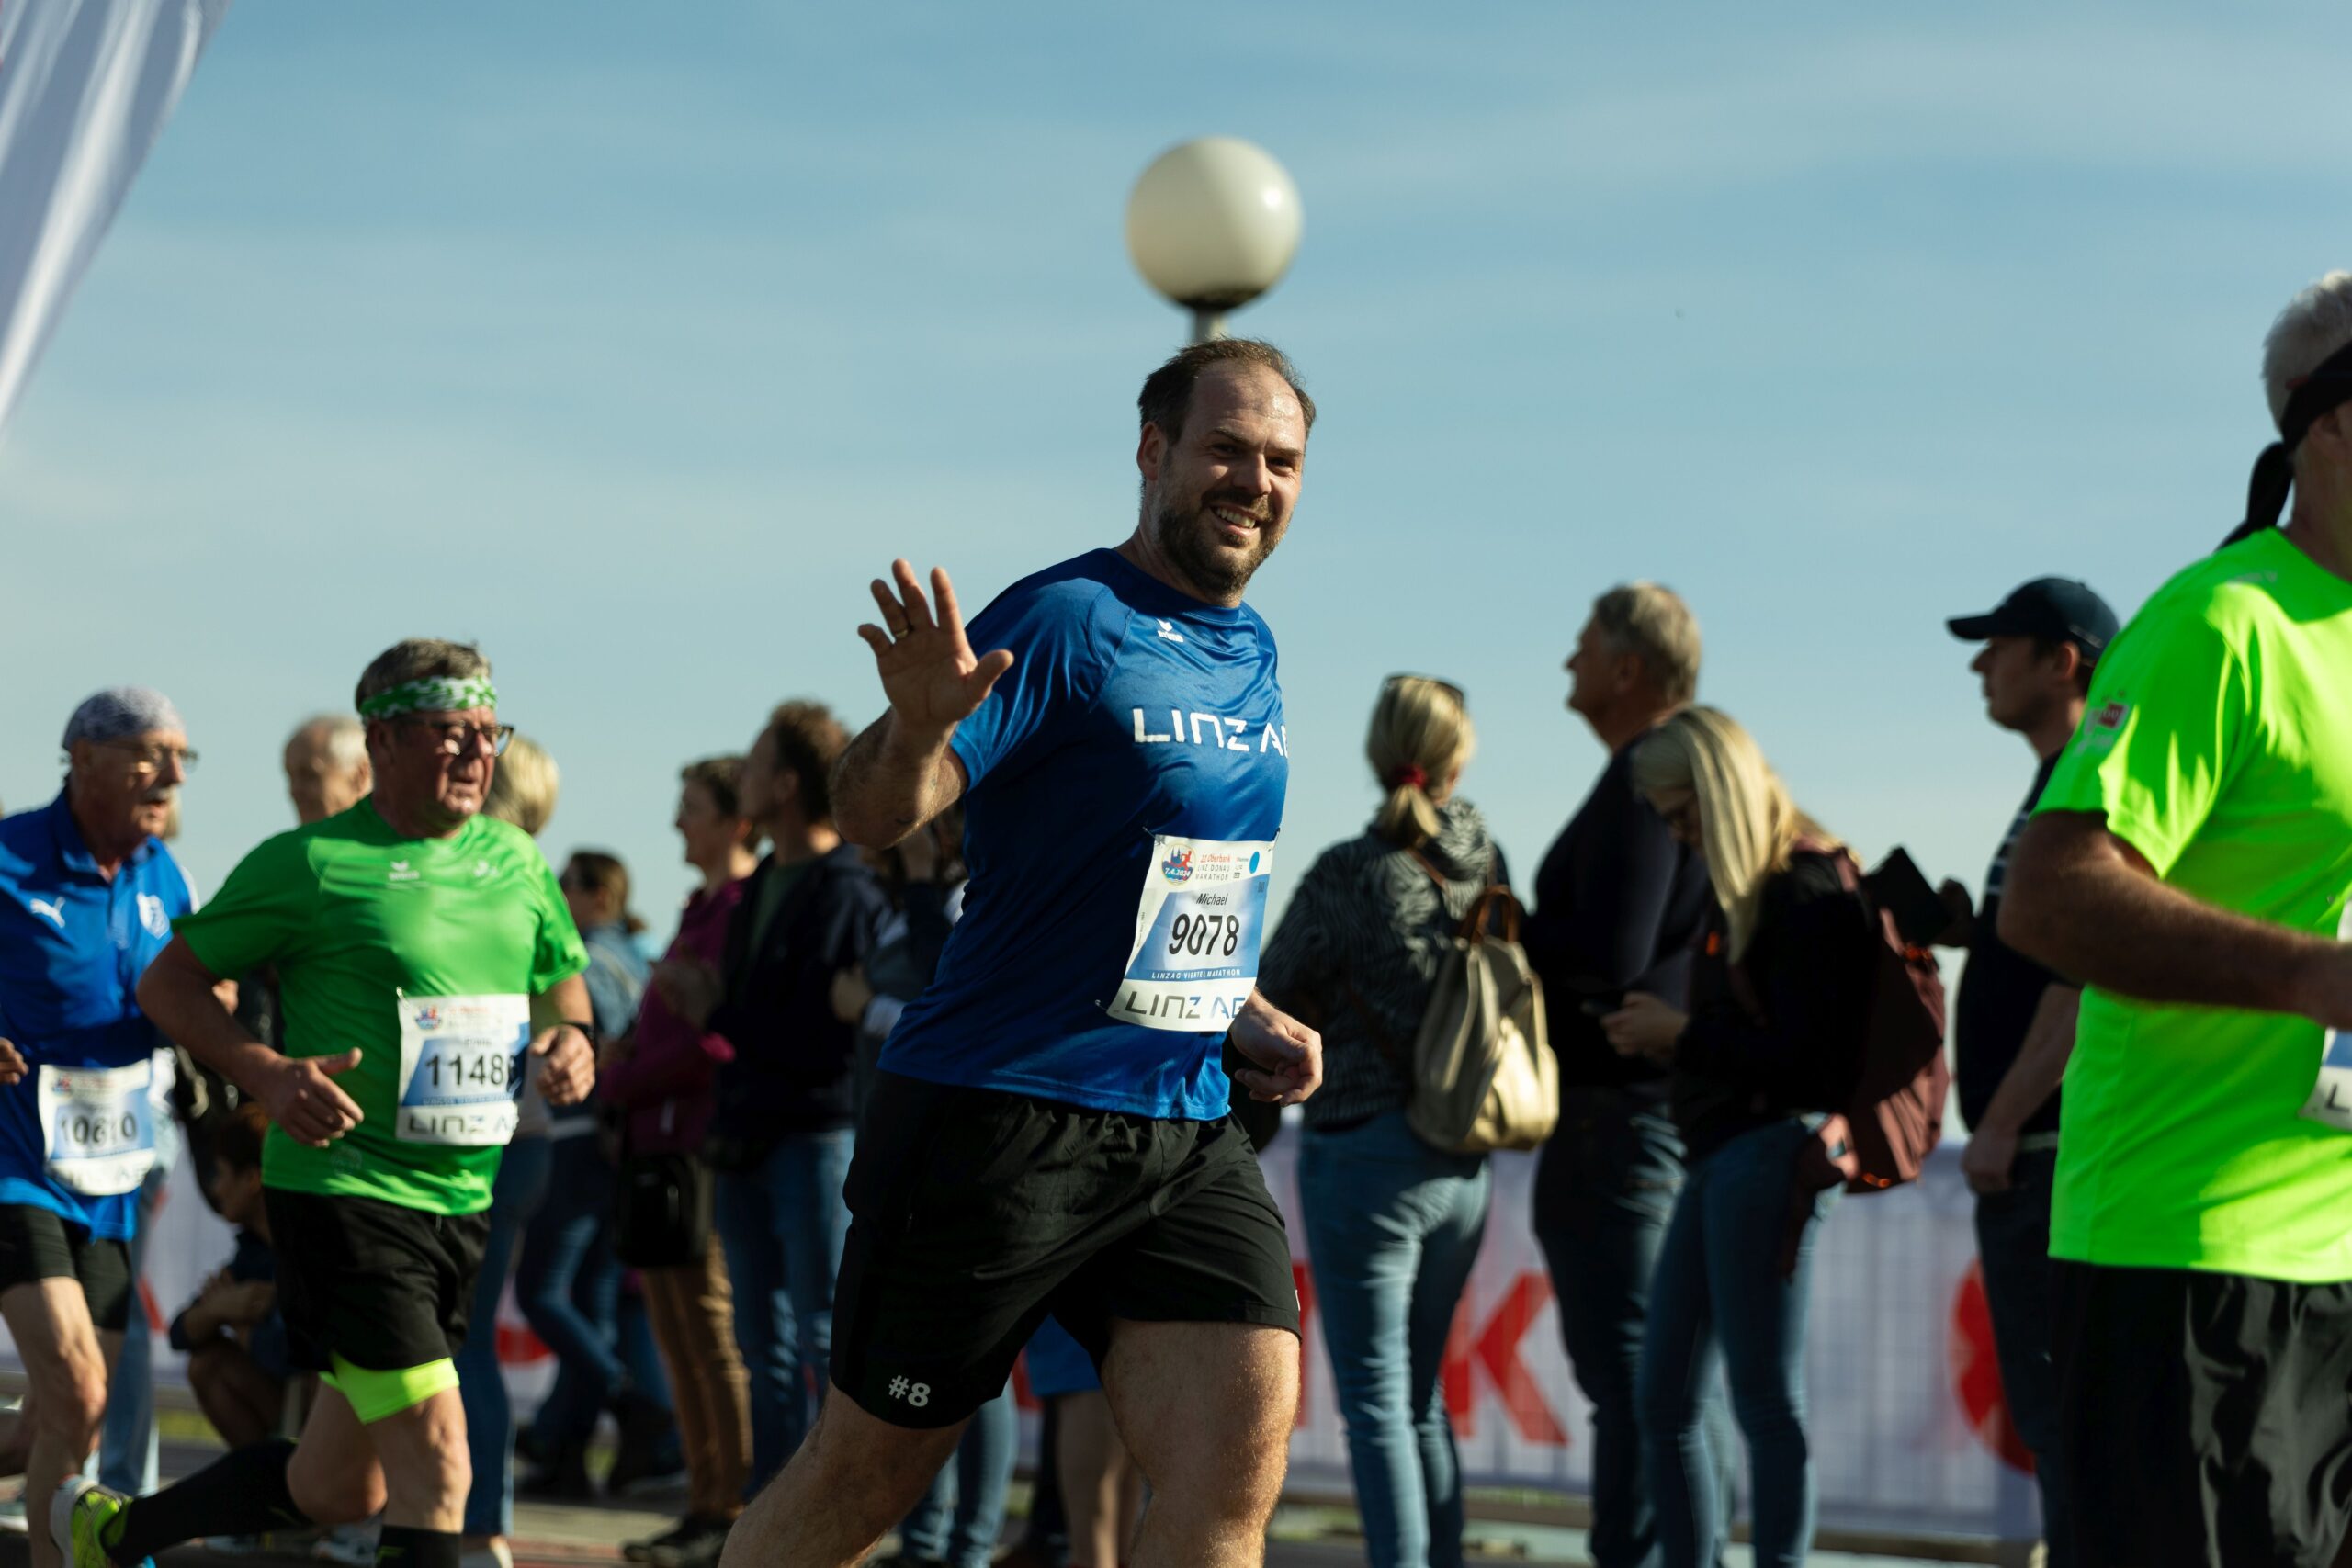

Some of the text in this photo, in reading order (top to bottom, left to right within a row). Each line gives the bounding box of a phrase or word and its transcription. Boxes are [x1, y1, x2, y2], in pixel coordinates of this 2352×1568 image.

[1133, 708, 1288, 758] LINZ A
[1207, 853, 1231, 863] Oberbank
[1195, 873, 1229, 881] MARATHON
[1195, 893, 1228, 906] Michael
[1168, 913, 1240, 957] 9078
[1124, 991, 1202, 1019] LINZ
[425, 1054, 514, 1089] 1148
[888, 1374, 931, 1407] #8
